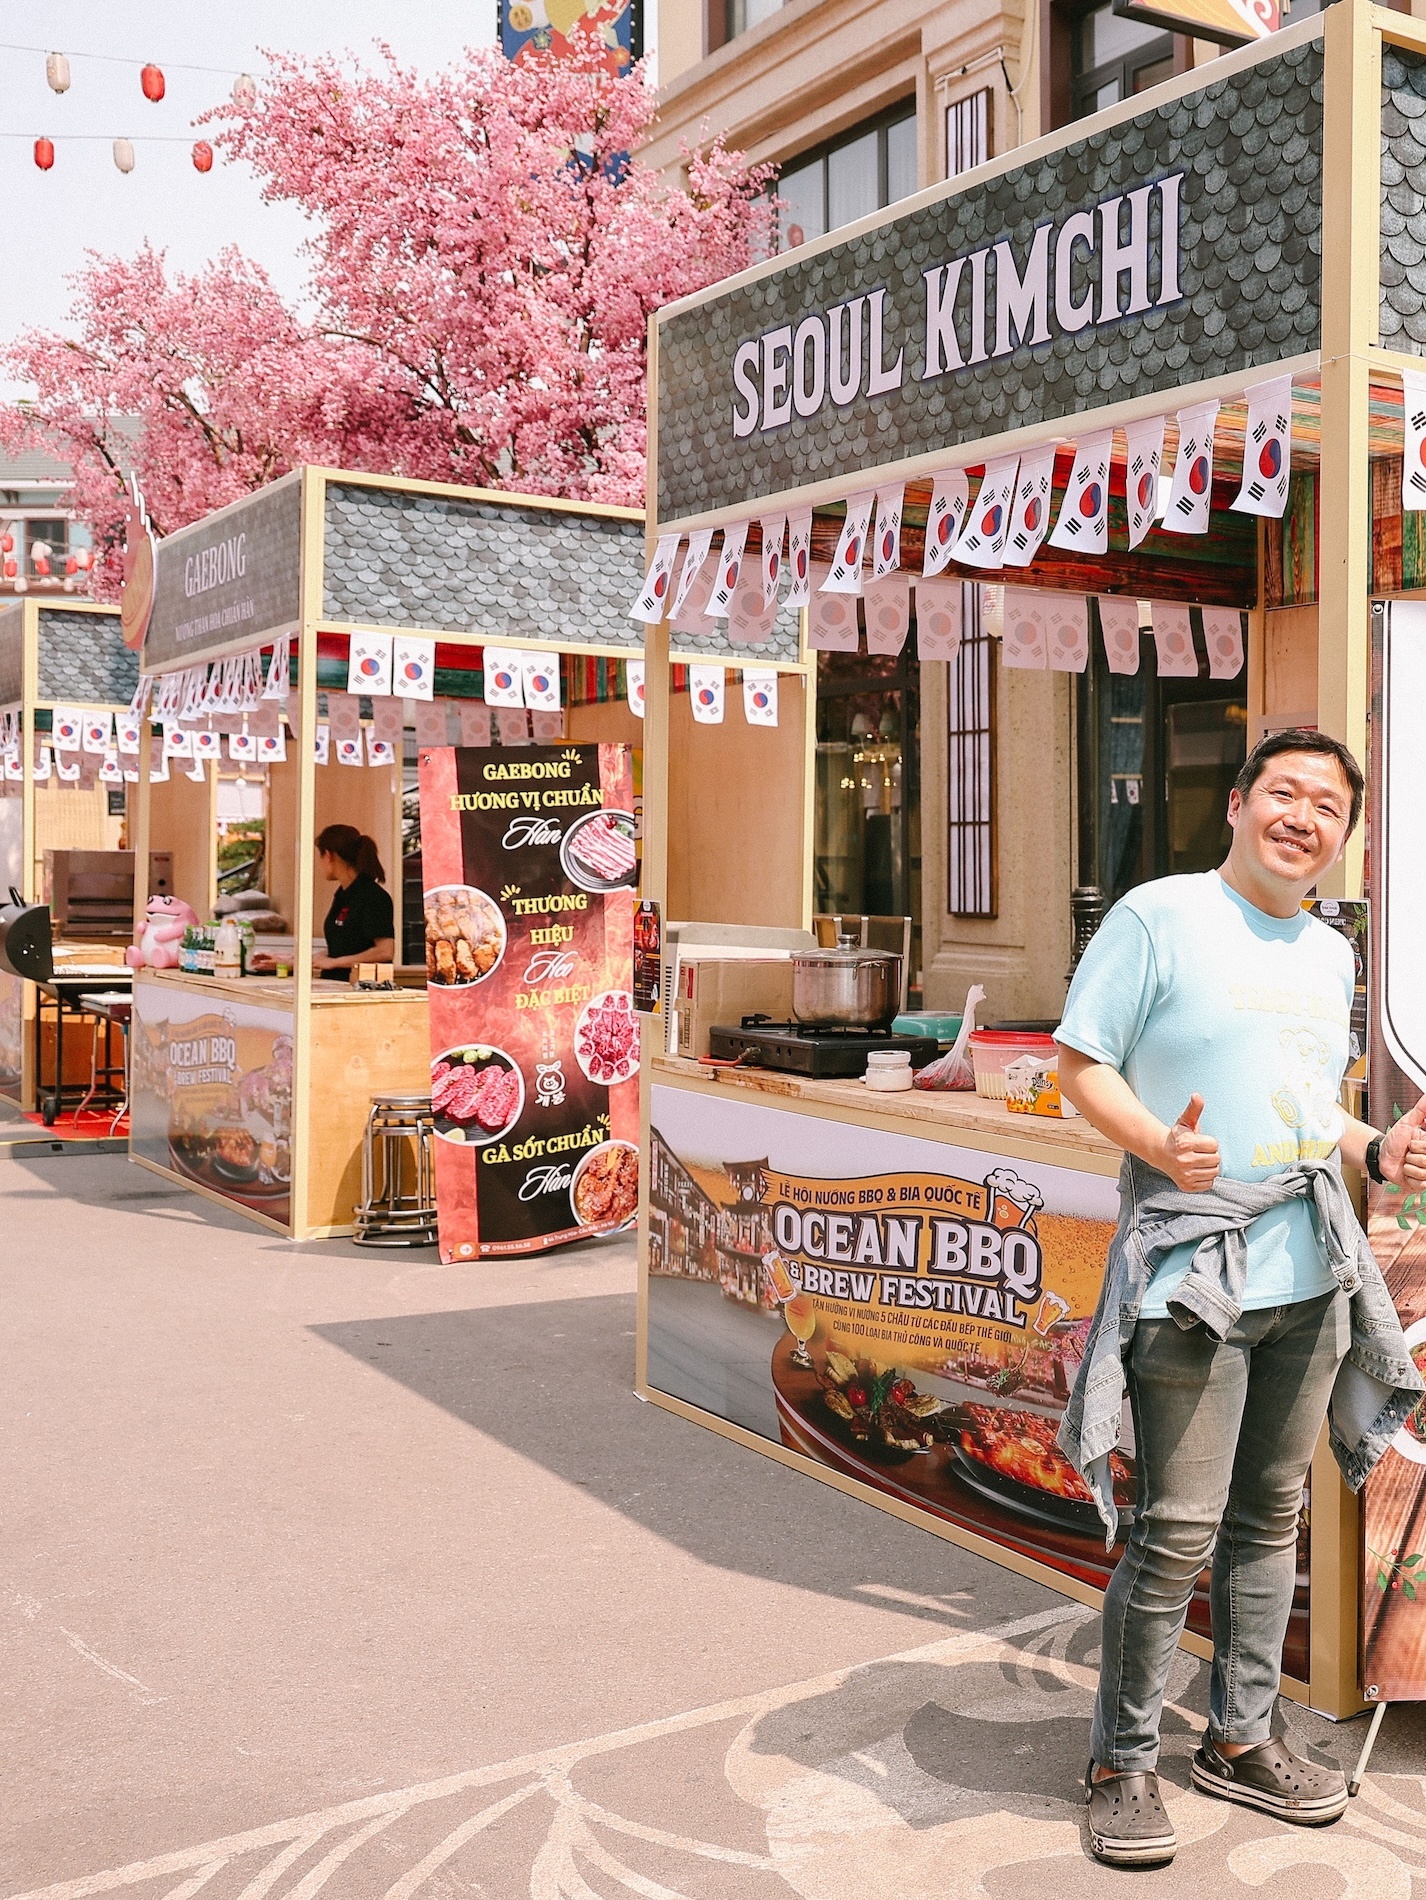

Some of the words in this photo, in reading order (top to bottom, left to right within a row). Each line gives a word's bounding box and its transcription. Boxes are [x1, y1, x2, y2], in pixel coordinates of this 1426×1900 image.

[733, 288, 903, 438] SEOUL
[922, 173, 1186, 380] KIMCHI
[185, 532, 246, 598] GAEBONG
[483, 761, 571, 781] GAEBONG
[450, 790, 519, 811] HƯƠNG
[519, 790, 541, 811] VỊ
[542, 782, 605, 807] CHUẨN
[502, 816, 563, 850] Hàn
[512, 893, 588, 915] THƯƠNG
[530, 924, 575, 947] HIỆU
[515, 988, 551, 1011] ĐẶC
[553, 983, 590, 1006] BIỆT
[170, 1039, 207, 1067] OCEAN
[210, 1036, 235, 1071] BBQ
[482, 1143, 512, 1165] GÀ
[512, 1135, 545, 1161] SỐT
[546, 1124, 604, 1155] CHUẨN
[518, 1163, 572, 1201] Hàn
[780, 1180, 790, 1198] LỄ
[793, 1186, 812, 1204] HỘI
[815, 1189, 855, 1205] NƯỚNG
[859, 1189, 883, 1203] BBQ
[886, 1187, 896, 1202] &
[899, 1186, 920, 1201] BIA
[924, 1184, 963, 1205] QUỐC
[966, 1191, 984, 1210] TẾ
[775, 1207, 919, 1268] OCEAN
[933, 1220, 1038, 1298] BBQ
[789, 1263, 800, 1278] &
[803, 1265, 875, 1303] BREW
[882, 1276, 1026, 1328] FESTIVAL
[849, 1307, 855, 1320] VỊ
[880, 1311, 886, 1322] 5
[887, 1311, 910, 1327] CHÂU
[911, 1315, 922, 1328] TỪ
[922, 1318, 939, 1330] CÁC
[959, 1321, 976, 1335] BẾP
[977, 1325, 995, 1339] THẾ
[852, 1323, 865, 1336] 100
[865, 1327, 880, 1340] LOẠI
[881, 1329, 892, 1341] BIA
[908, 1333, 931, 1347] CÔNG
[945, 1338, 969, 1353] QUỐC
[970, 1341, 982, 1355] TẾ
